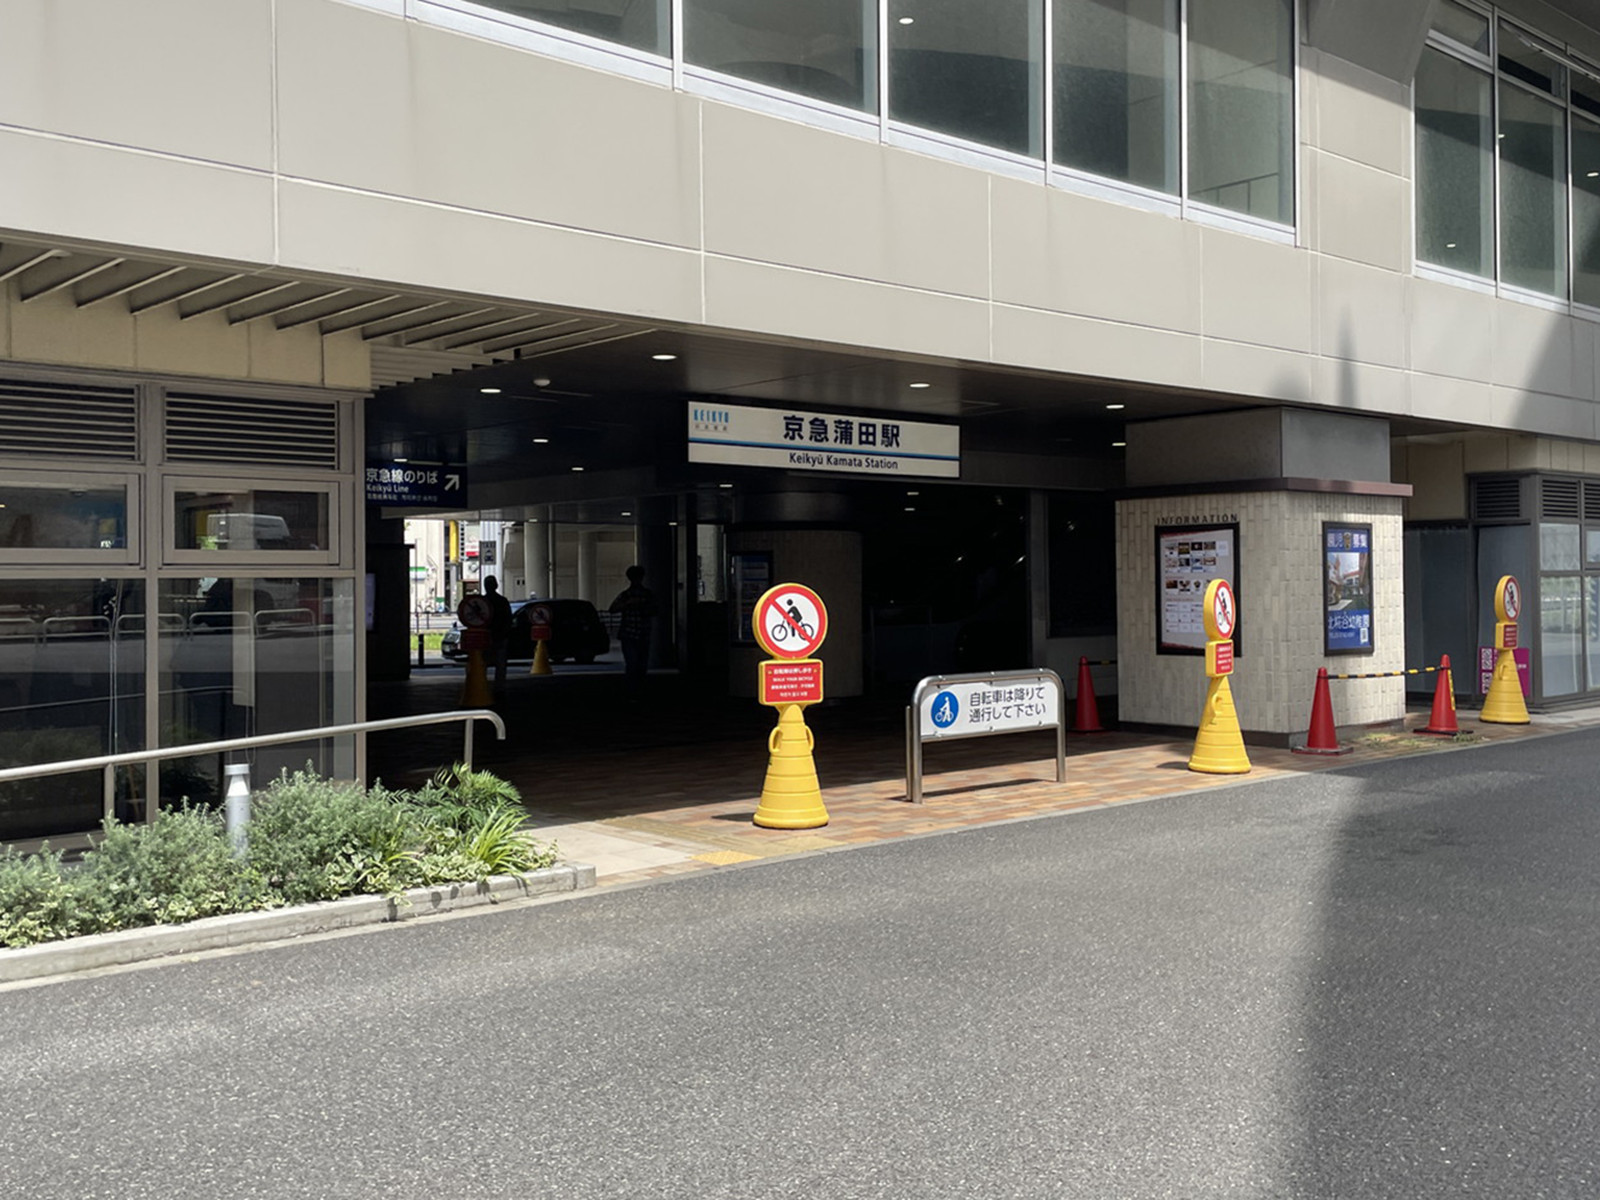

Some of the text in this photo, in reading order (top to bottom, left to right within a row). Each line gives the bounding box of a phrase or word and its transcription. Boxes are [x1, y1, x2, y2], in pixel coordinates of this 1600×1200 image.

[783, 414, 901, 448] 京急蒲田駅
[826, 456, 863, 468] Kamata
[865, 458, 899, 470] Station
[366, 468, 439, 484] 京急線のりば
[393, 485, 409, 493] Line
[1157, 513, 1238, 525] INFORMATION
[969, 687, 1045, 707] 自転車は降りて
[969, 703, 1046, 723] 通行して下さい
